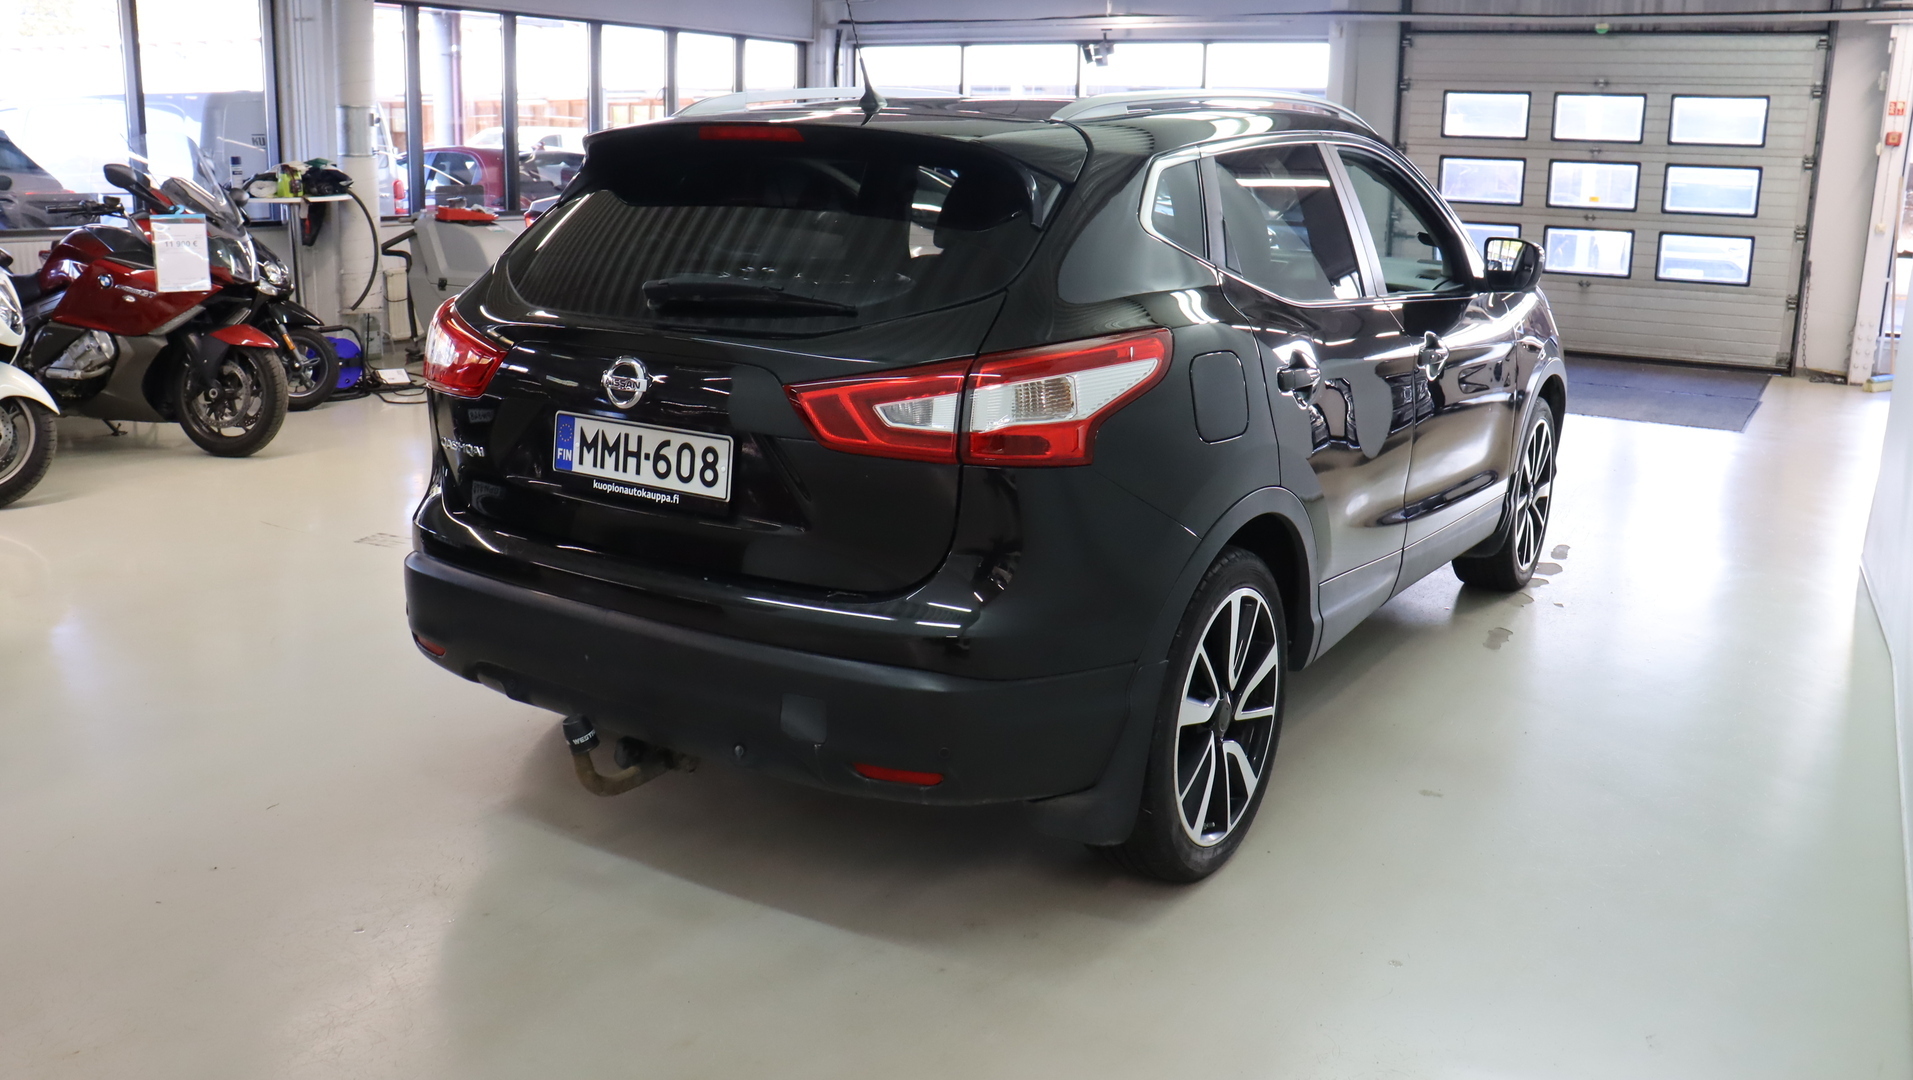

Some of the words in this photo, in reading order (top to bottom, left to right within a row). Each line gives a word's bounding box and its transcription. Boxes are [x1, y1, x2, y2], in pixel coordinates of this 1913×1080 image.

[605, 378, 641, 389] NISSAN
[440, 436, 485, 457] QASHQAI
[557, 448, 572, 461] FIN
[578, 426, 719, 488] MMH-608
[593, 479, 680, 504] kuopionautokauppa.fi
